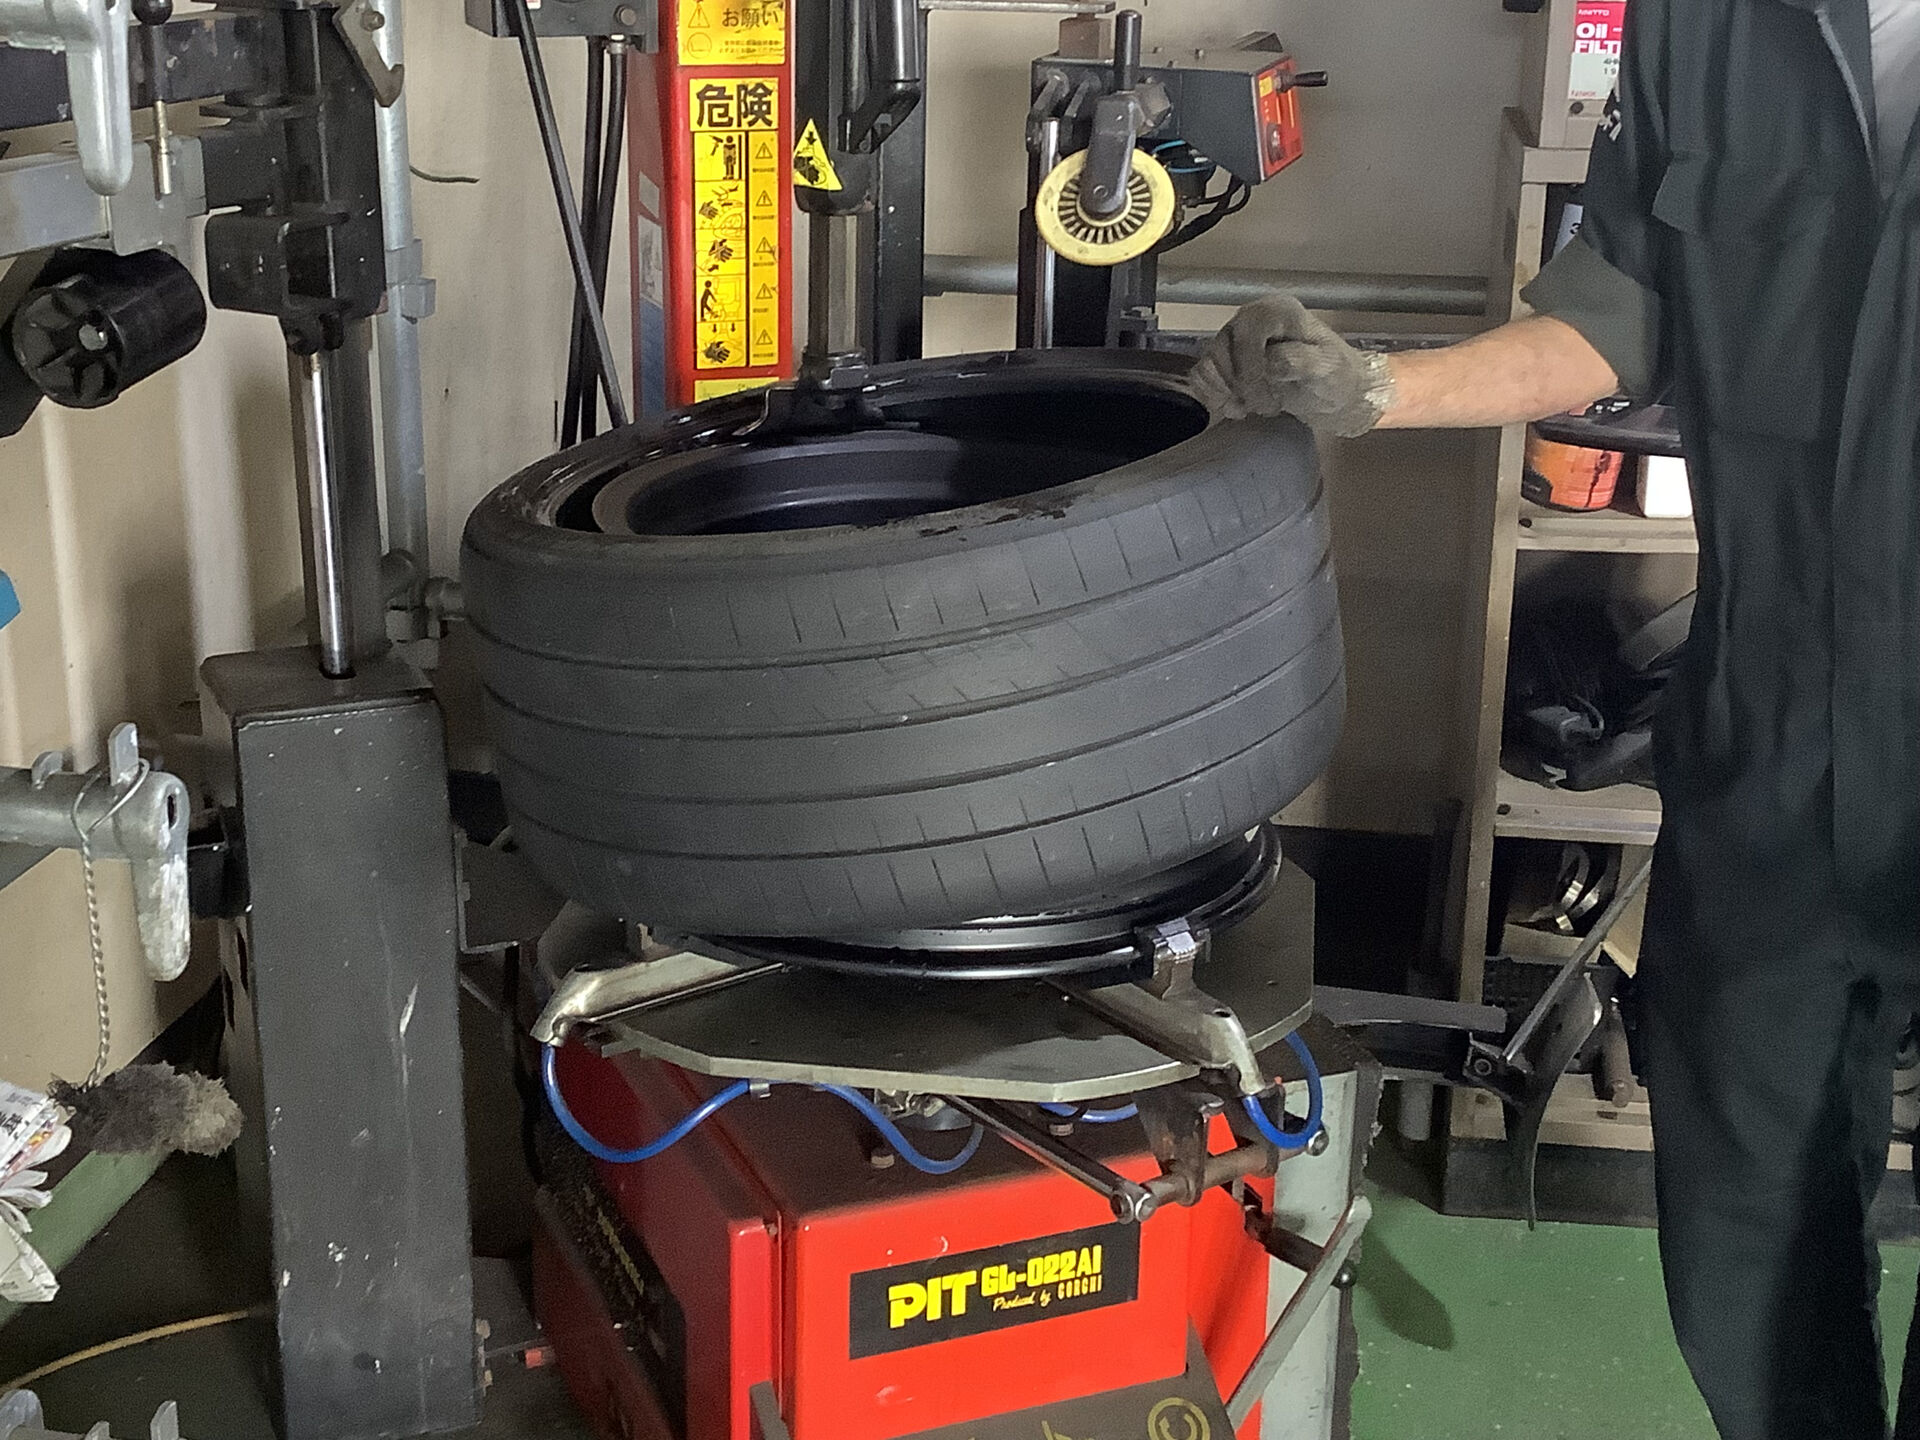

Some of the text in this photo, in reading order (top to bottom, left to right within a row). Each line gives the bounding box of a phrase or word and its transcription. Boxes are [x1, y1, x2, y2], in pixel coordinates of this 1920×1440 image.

[721, 7, 780, 27] お願い
[696, 83, 773, 128] 危険
[888, 1270, 977, 1329] PIT
[993, 1290, 1036, 1312] Produced
[1040, 1288, 1052, 1308] by
